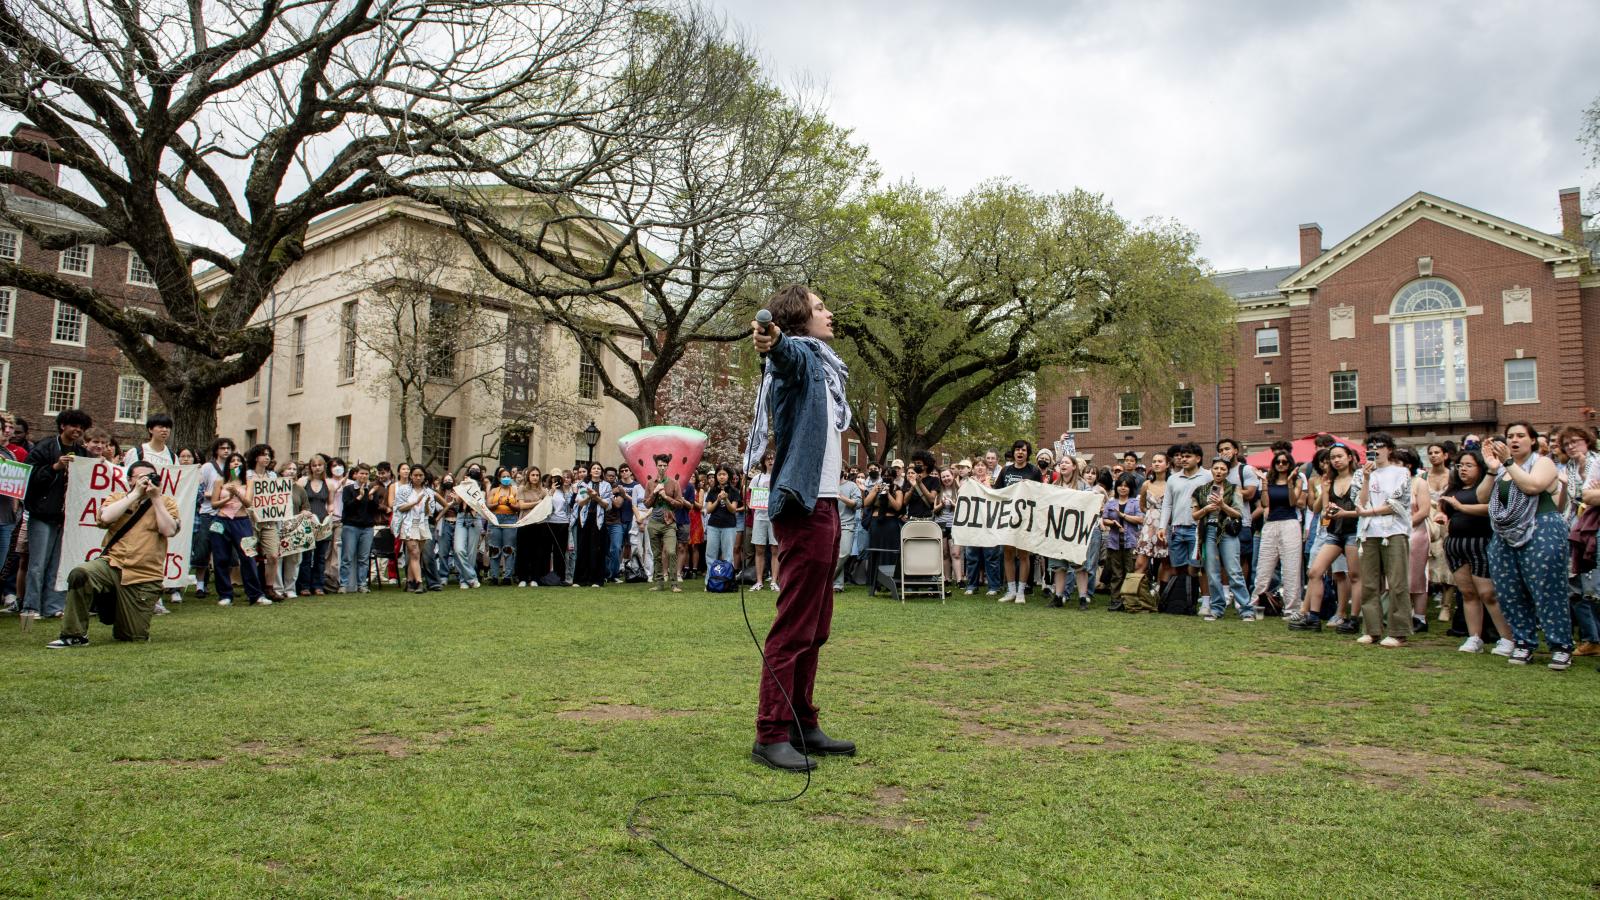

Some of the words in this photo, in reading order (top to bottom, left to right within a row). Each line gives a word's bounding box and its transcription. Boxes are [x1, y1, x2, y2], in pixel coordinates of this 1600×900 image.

[90, 463, 182, 496] BRN
[254, 479, 292, 495] BROWN
[253, 493, 290, 508] DIVEST
[753, 490, 769, 499] BRO
[262, 506, 286, 518] NOW
[953, 496, 1036, 532] DIVEST
[1045, 504, 1099, 546] NOW
